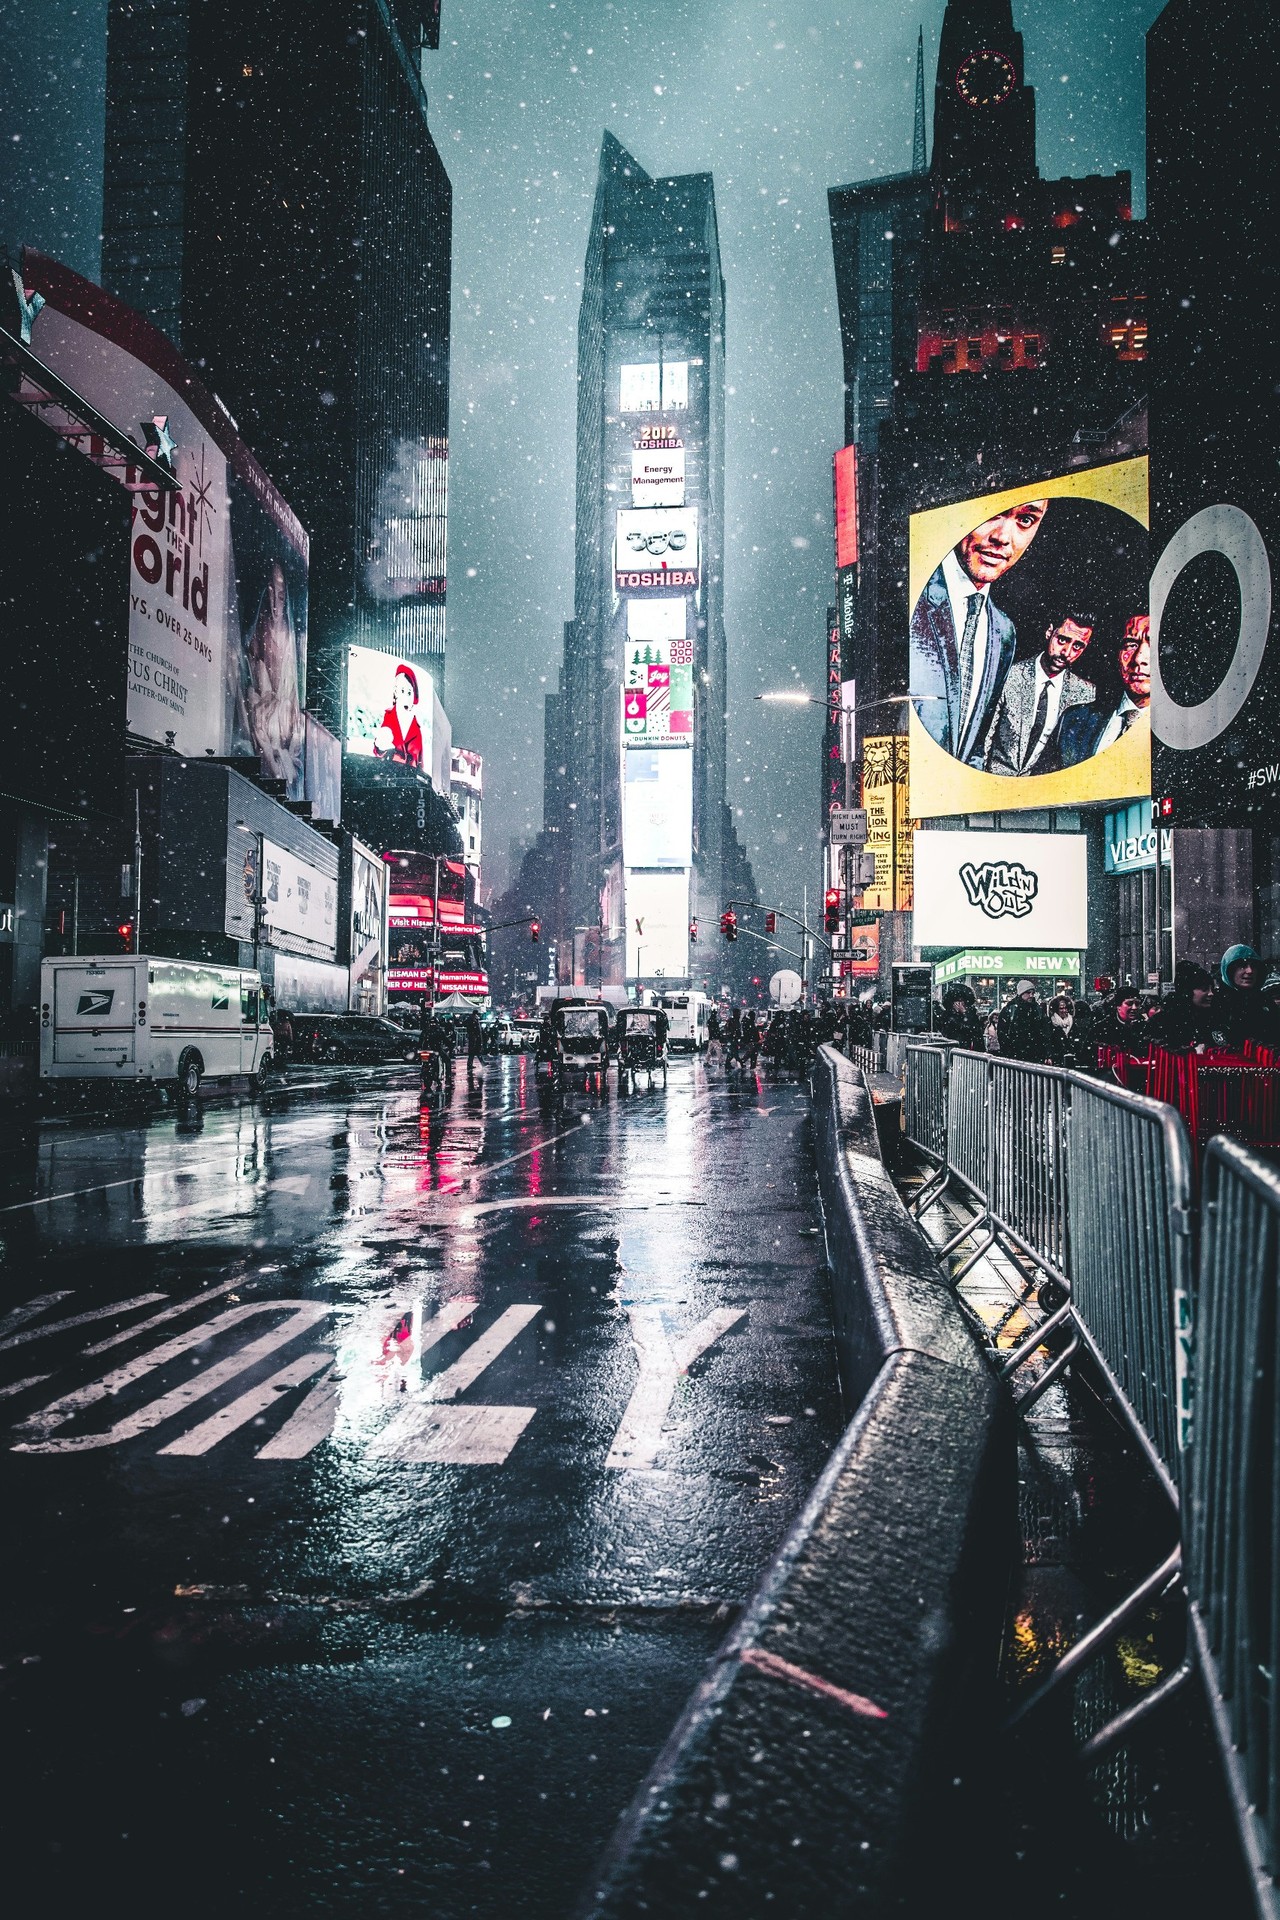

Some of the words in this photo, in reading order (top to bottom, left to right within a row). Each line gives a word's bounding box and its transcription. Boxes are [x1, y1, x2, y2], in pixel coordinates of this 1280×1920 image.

[634, 439, 683, 449] TOSHIBA
[633, 477, 683, 485] Management
[165, 526, 183, 553] THE
[132, 534, 209, 627] orld
[617, 571, 696, 587] TOSHIBA
[156, 608, 181, 638] OVER
[183, 628, 192, 646] 25
[194, 636, 212, 662] DAYS
[128, 642, 144, 657] THE
[145, 651, 173, 673] CHURCH
[173, 666, 180, 676] OF
[648, 670, 669, 683] Joy
[153, 670, 188, 703] CHRIST
[128, 680, 169, 706] LATTER-DAY
[169, 699, 185, 716] SAINTS
[829, 745, 840, 759] &
[870, 807, 884, 816] THE
[839, 823, 859, 831] MUST
[868, 817, 888, 828] LION
[1026, 957, 1063, 970] NEW
[441, 983, 468, 991] NISSAN
